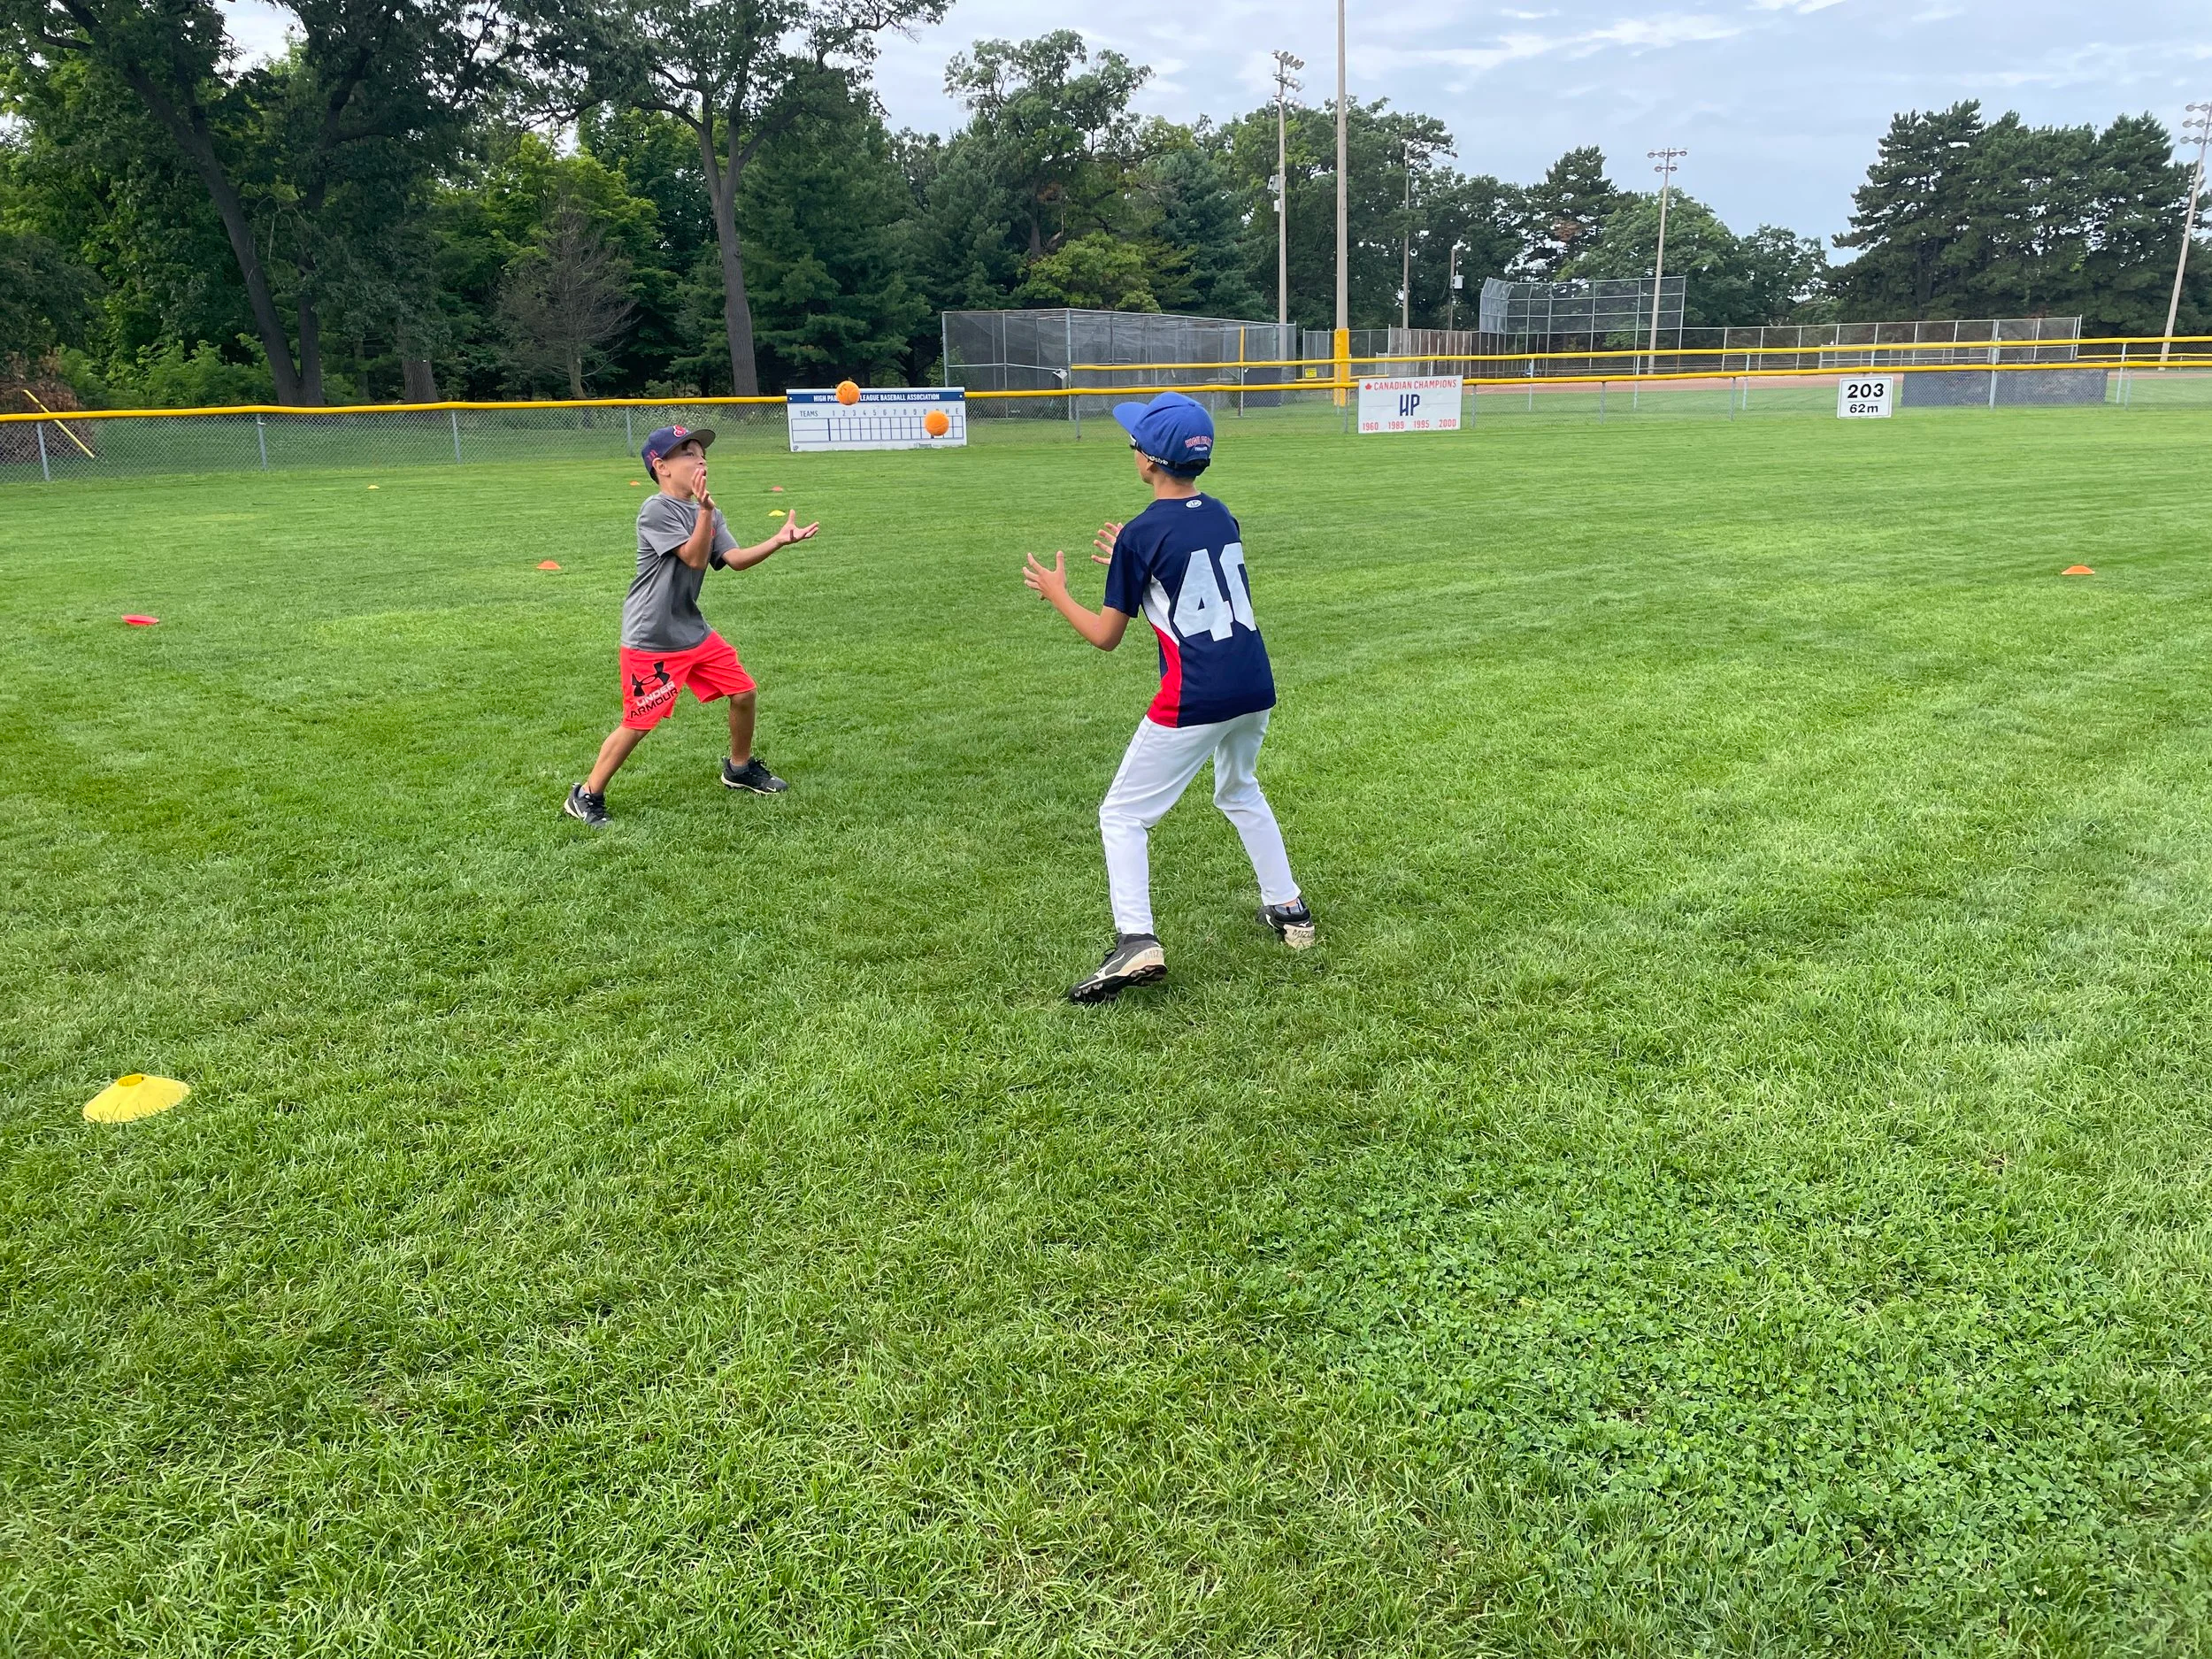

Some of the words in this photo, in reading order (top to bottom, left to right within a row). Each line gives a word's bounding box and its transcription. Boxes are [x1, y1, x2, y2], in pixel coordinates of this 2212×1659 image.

[1373, 381, 1412, 390] CANADIAN
[1414, 379, 1457, 389] CHAMPIONS
[1847, 383, 1884, 398] 203
[1849, 403, 1878, 413] 62m
[1363, 422, 1379, 431] 1960
[1388, 420, 1404, 429] 1989
[1414, 419, 1430, 428] 1995
[1439, 419, 1456, 427] 2000
[1173, 541, 1257, 641] 40
[636, 680, 675, 707] UNDER
[630, 687, 679, 718] ARMOUR
